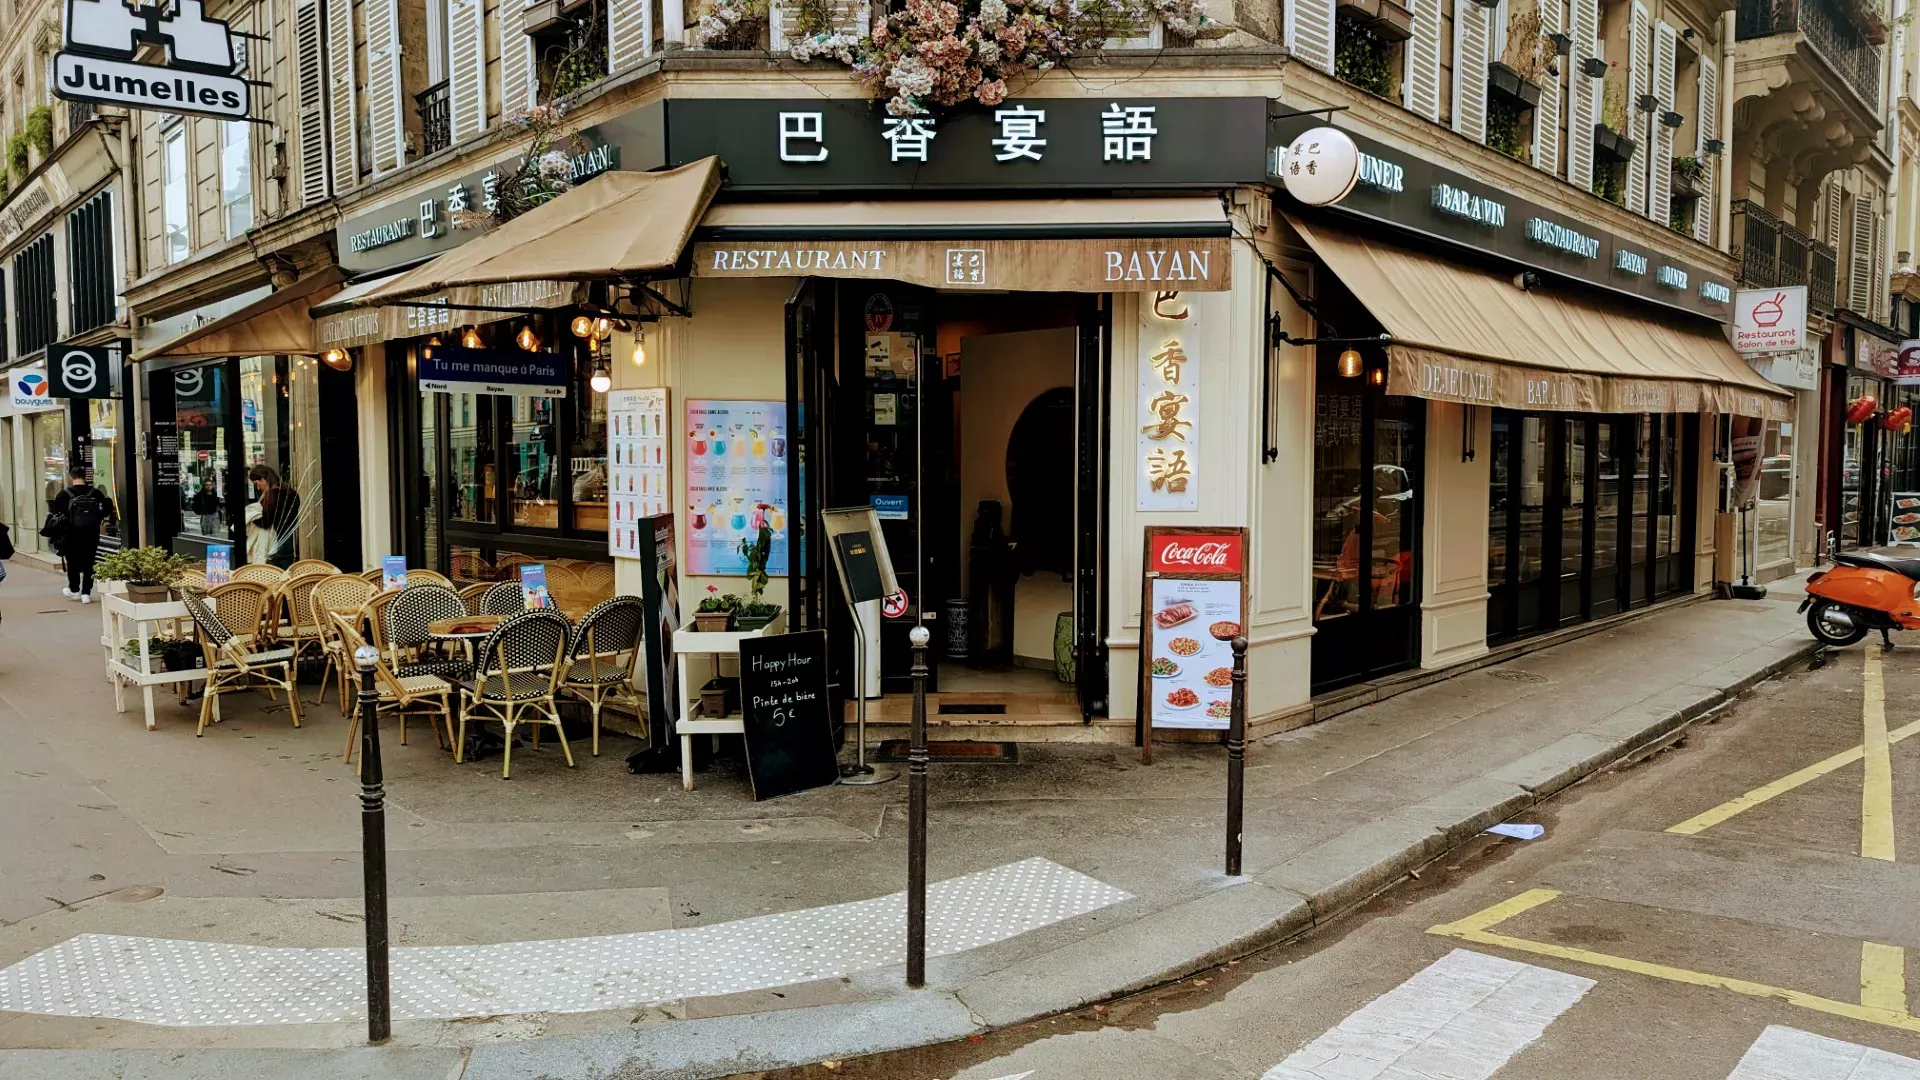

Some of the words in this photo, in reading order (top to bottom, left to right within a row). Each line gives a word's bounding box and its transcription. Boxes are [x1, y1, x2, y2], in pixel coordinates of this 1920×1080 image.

[63, 64, 241, 109] Jumelles
[778, 102, 1158, 162] 巴香宴語
[1440, 184, 1469, 216] BAR
[1483, 199, 1506, 227] VIN
[350, 217, 412, 252] RESTAURANT
[1533, 217, 1600, 260] RESTAURANT
[711, 249, 887, 272] RESTAURANT
[1104, 250, 1211, 281] BAYAN
[1620, 249, 1648, 275] BAYAN
[482, 281, 534, 308] RESTAURANT
[1705, 281, 1730, 303] SOUPER
[1738, 328, 1796, 340] Restaurant
[1738, 341, 1763, 349] Salon
[1781, 338, 1796, 346] thé
[433, 358, 448, 371] Tu
[452, 362, 470, 372] me
[473, 363, 518, 376] manque
[521, 364, 528, 375] à
[529, 364, 556, 376] Paris
[15, 398, 53, 406] bouygues
[1527, 379, 1548, 405] BAR
[875, 498, 902, 506] Ouvert
[752, 654, 785, 672] Happy
[788, 652, 812, 667] Hour
[753, 696, 779, 709] Pinte
[783, 693, 793, 704] de
[796, 691, 816, 702] bière
[773, 707, 786, 727] 5
